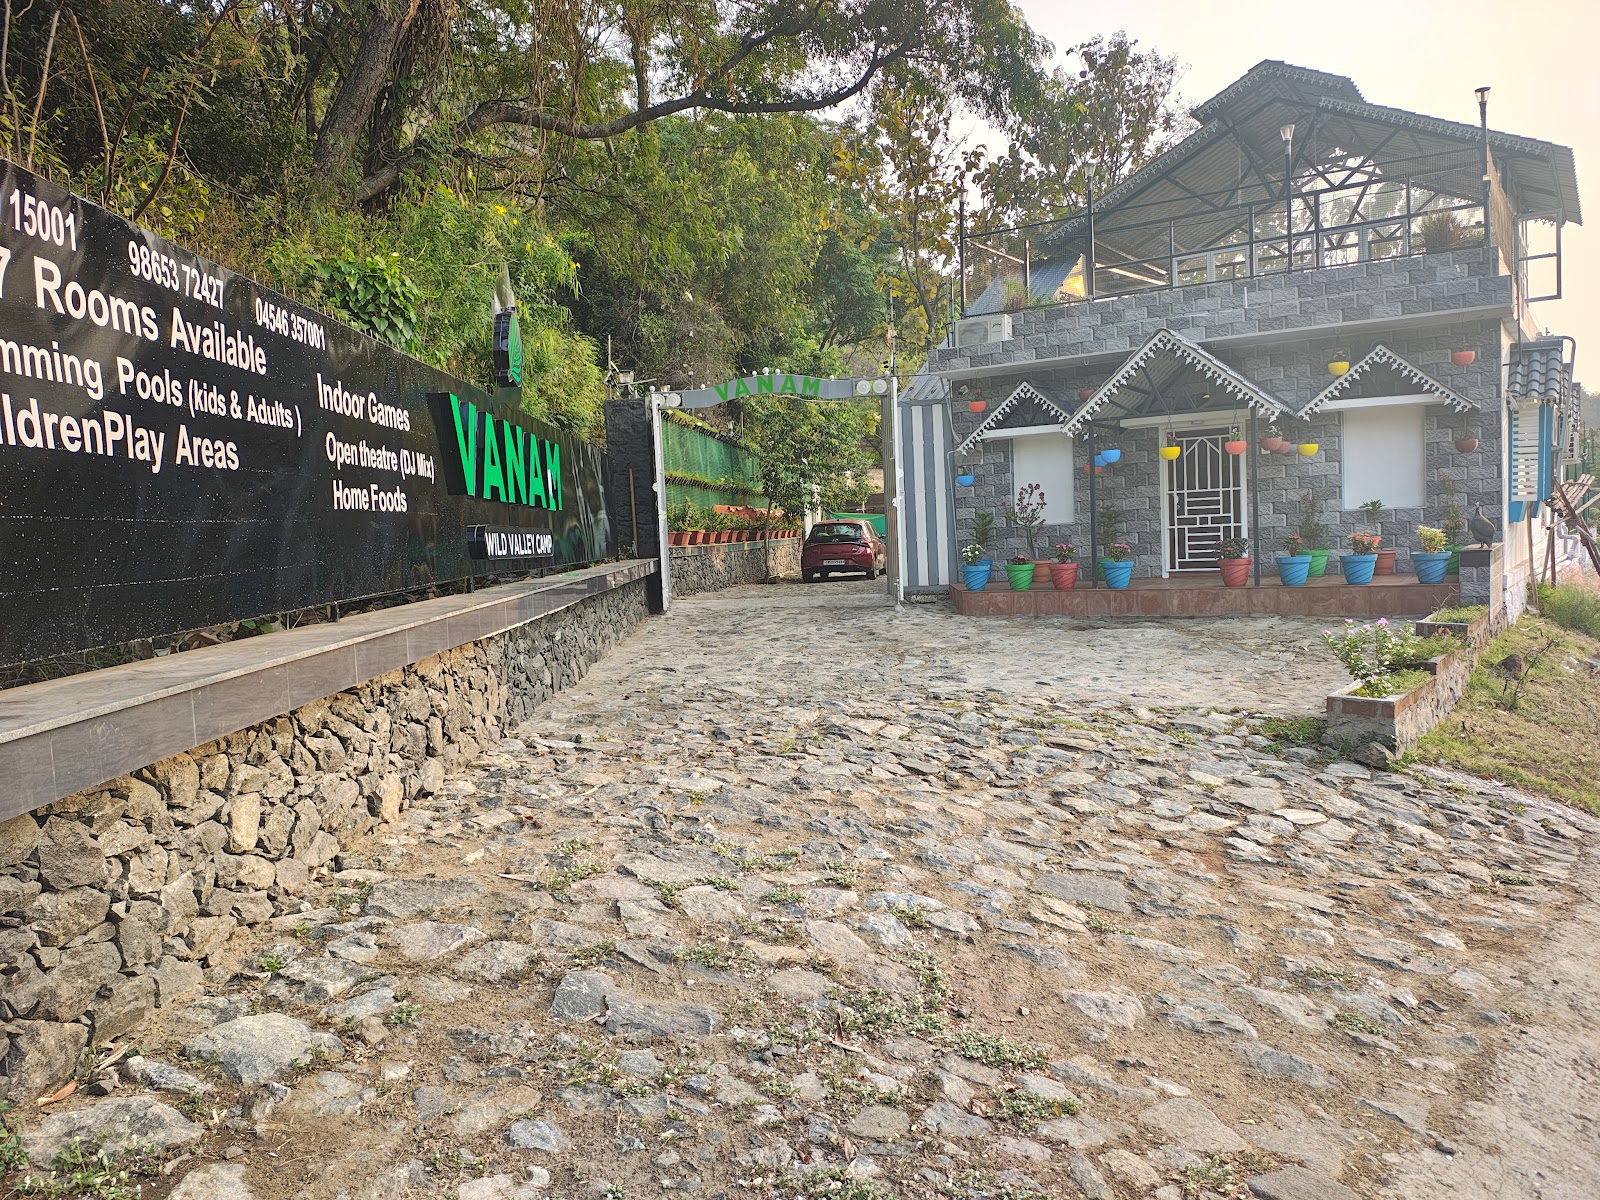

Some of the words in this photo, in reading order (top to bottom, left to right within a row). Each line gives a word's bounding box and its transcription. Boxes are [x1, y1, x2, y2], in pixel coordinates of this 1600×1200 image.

[9, 188, 77, 252] 15001
[128, 240, 180, 291] 98653
[181, 264, 224, 309] 72427
[33, 255, 159, 341] Rooms
[170, 306, 267, 375] Available
[255, 297, 289, 337] 04546
[290, 313, 326, 350] 357001
[116, 356, 183, 407] Pools
[188, 378, 226, 418] (kids
[229, 389, 243, 420] &
[316, 372, 366, 420] Indoor
[367, 391, 411, 432] Games
[713, 374, 822, 401] VANAM
[175, 424, 240, 471] Areas
[325, 431, 359, 471] Open
[358, 440, 398, 472] theatre
[399, 448, 417, 480] (DJ
[416, 452, 435, 485] Mix)
[449, 393, 564, 512] VANAM
[332, 479, 370, 511] Home
[369, 483, 408, 513] Foods
[484, 532, 508, 557] WILD
[507, 533, 535, 556] VALLEY
[534, 533, 553, 555] CAMP
